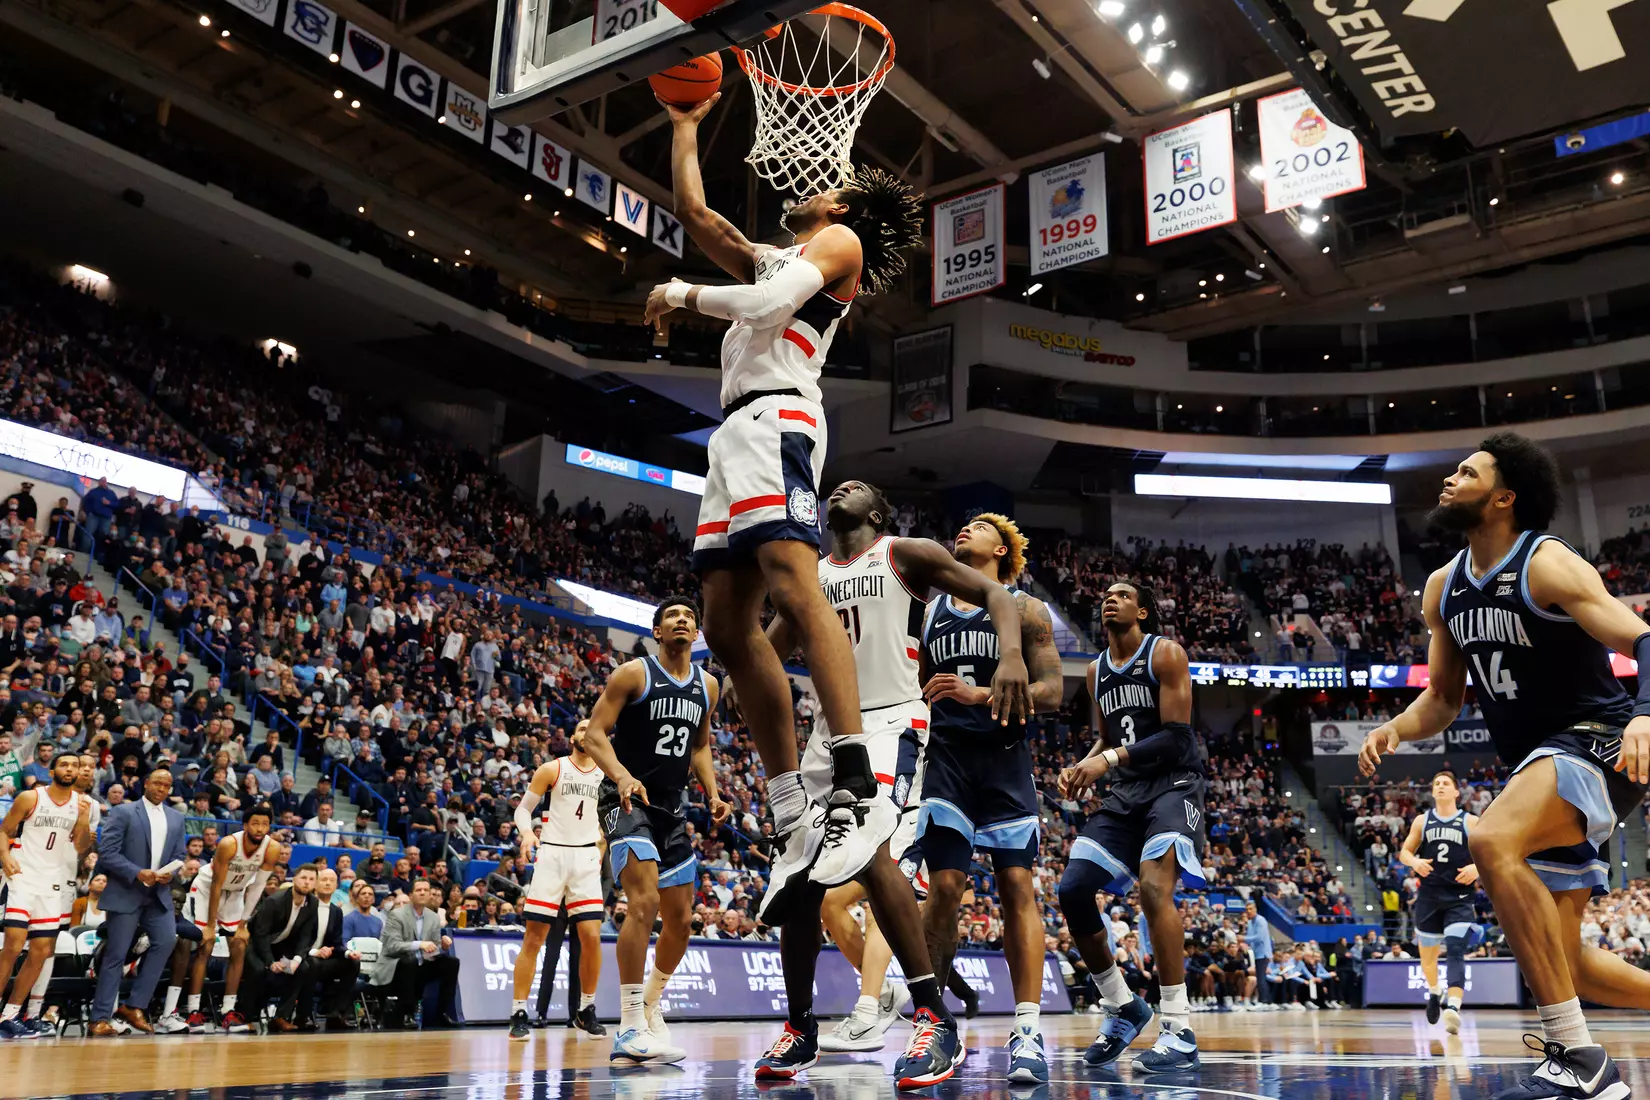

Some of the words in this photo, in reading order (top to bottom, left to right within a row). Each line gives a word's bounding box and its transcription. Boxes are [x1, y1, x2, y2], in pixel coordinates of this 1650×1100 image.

[400, 64, 434, 109] G
[1274, 141, 1351, 179] 2002
[1278, 178, 1352, 204] CHAMPIONS
[1282, 168, 1345, 190] NATIONAL
[1152, 176, 1225, 213] 2000
[1158, 212, 1224, 237] CHAMPIONS
[1161, 202, 1218, 224] NATIONAL
[1039, 214, 1097, 246] 1999
[943, 244, 996, 275] 1995
[1039, 247, 1100, 271] CHAMPIONS
[1042, 238, 1095, 258] NATIONAL
[941, 276, 998, 299] CHAMPIONS
[945, 268, 995, 287] NATIONAL
[1009, 324, 1102, 351] megabus
[596, 456, 628, 472] pepsi
[227, 516, 250, 530] 116
[823, 575, 885, 606] NNECTICUT
[1448, 607, 1533, 651] VILLANOVA
[1471, 650, 1519, 702] 14
[650, 697, 702, 728] VILLANOVA
[1099, 684, 1155, 718] VILLANOVA
[655, 724, 690, 757] 23
[1120, 715, 1136, 747] 3
[575, 800, 584, 820] 4
[46, 832, 57, 850] 0
[1425, 827, 1462, 846] VILLANOVA
[1437, 843, 1449, 863] 2
[742, 951, 783, 976] UCO
